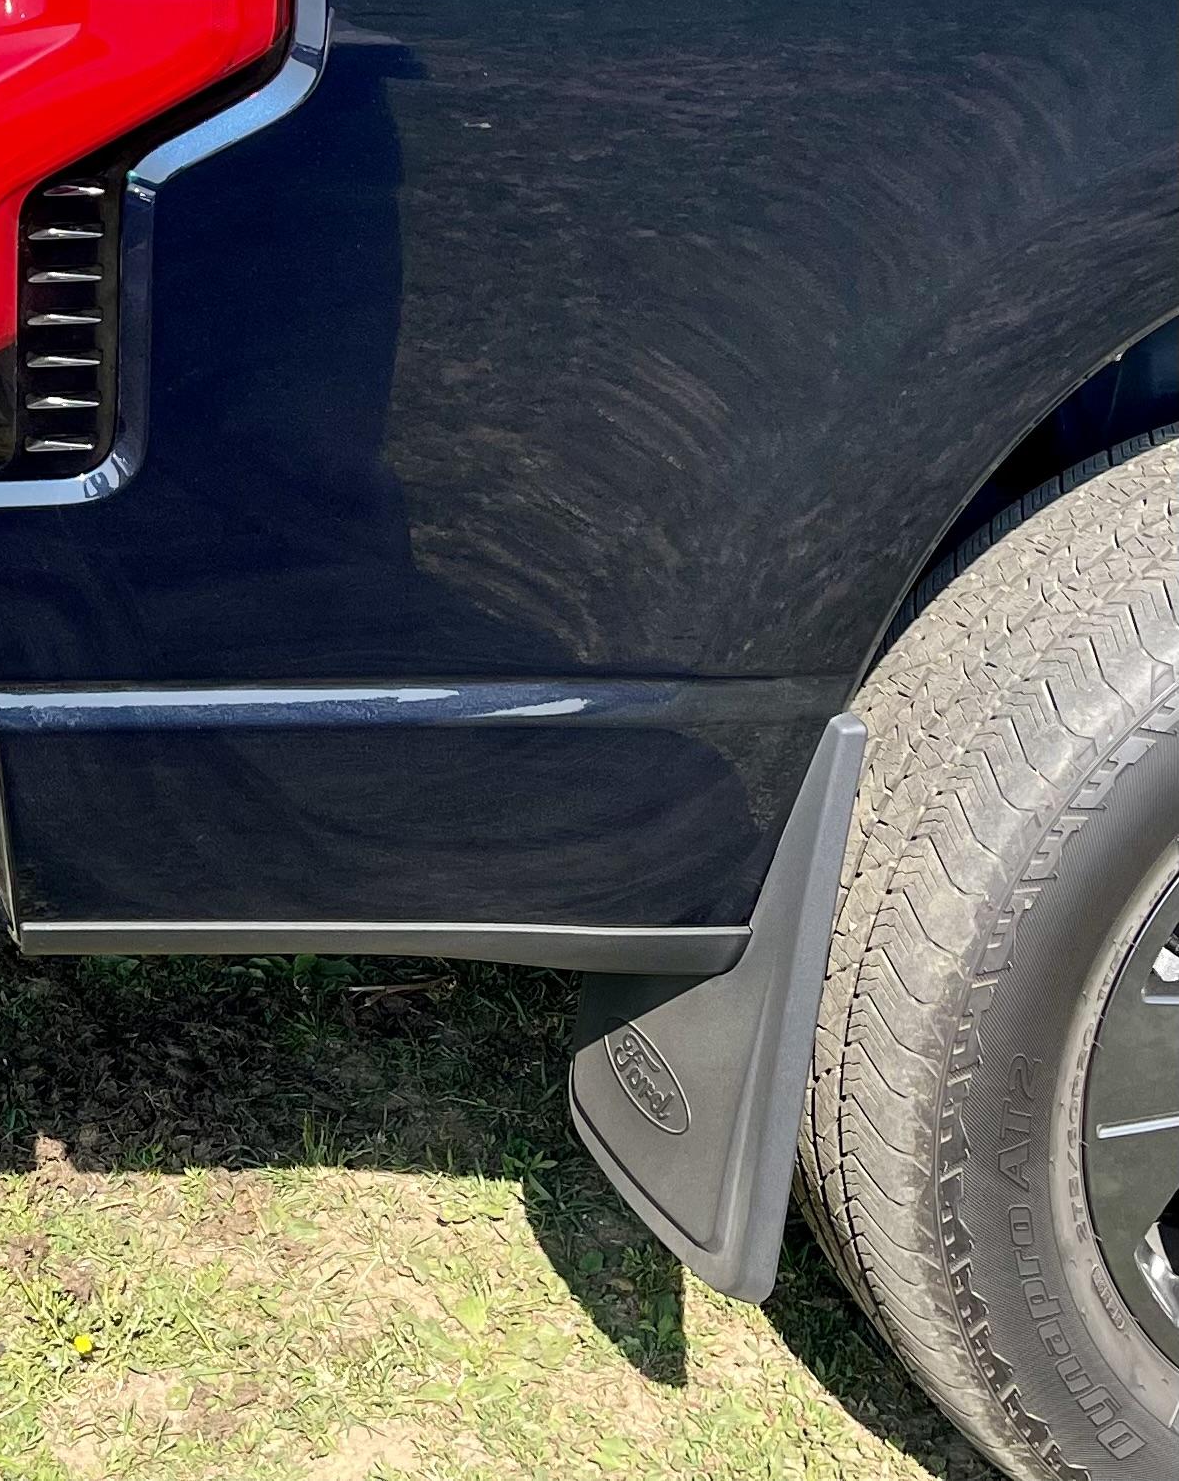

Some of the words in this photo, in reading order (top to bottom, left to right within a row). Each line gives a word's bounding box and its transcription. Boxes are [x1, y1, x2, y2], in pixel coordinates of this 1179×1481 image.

[613, 1030, 676, 1121] Ford
[998, 1052, 1043, 1192] AT2
[1008, 1205, 1148, 1461] Dynapro
